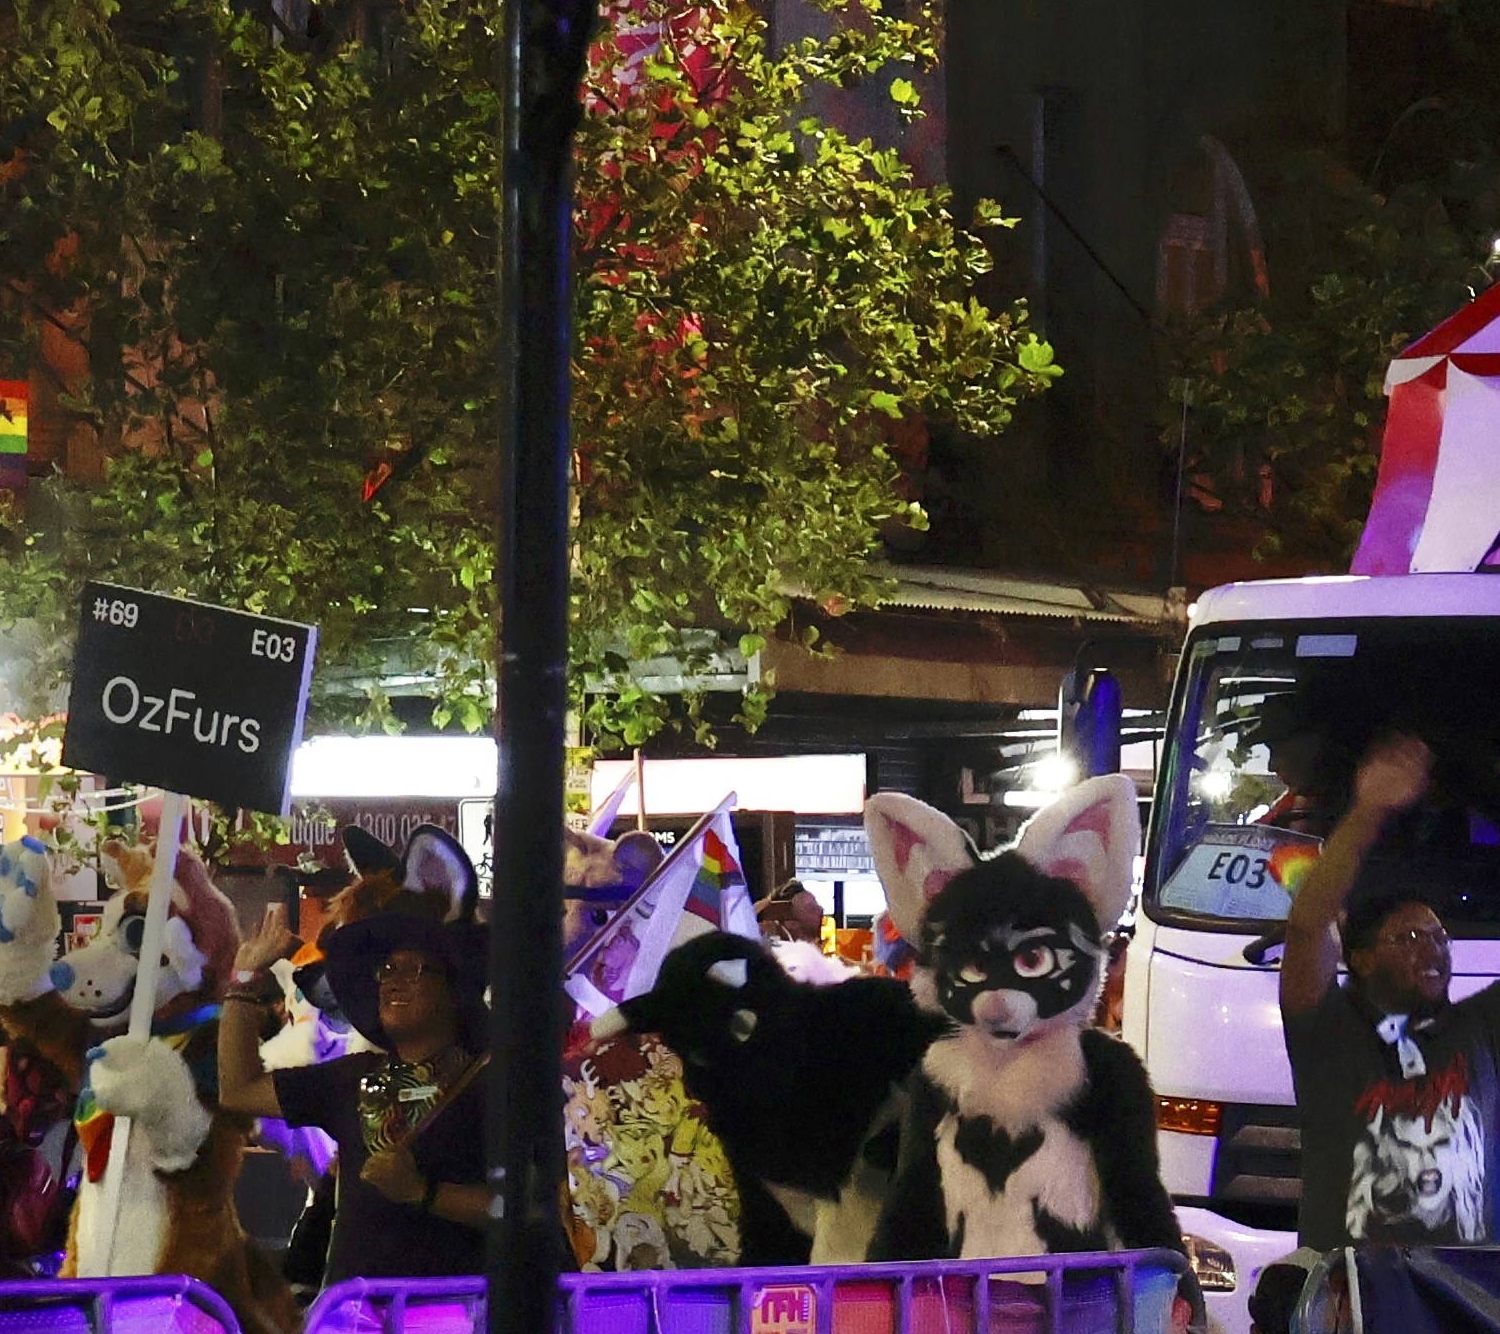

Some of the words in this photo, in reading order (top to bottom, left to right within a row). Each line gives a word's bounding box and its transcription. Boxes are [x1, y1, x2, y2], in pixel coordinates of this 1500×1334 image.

[92, 597, 139, 629] #69
[251, 628, 296, 663] E03
[102, 676, 261, 753] OzFurs
[1207, 851, 1268, 890] E03
